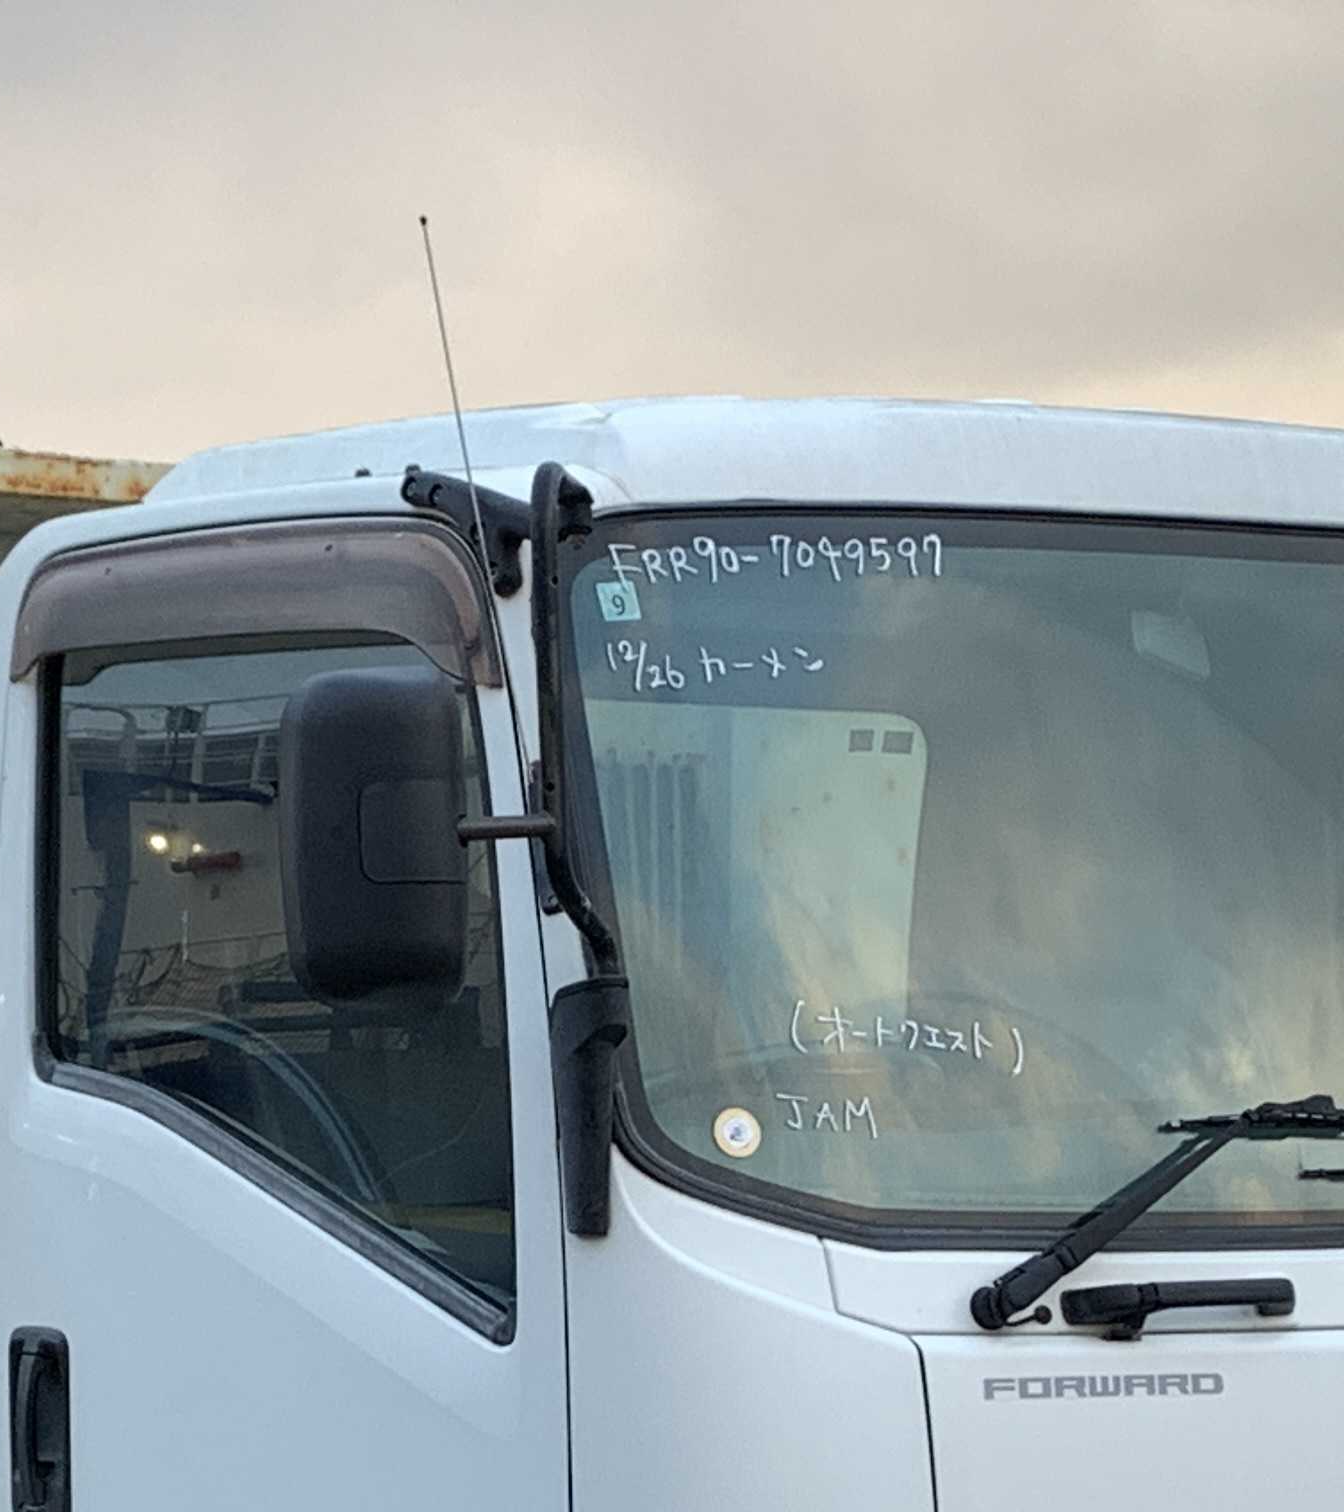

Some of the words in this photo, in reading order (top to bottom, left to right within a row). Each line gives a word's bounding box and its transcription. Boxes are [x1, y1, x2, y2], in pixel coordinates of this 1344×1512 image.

[607, 533, 943, 593] FRR90-7049597
[611, 593, 626, 617] 9
[605, 639, 686, 692] 12/26
[775, 1093, 879, 1140] JAM
[982, 1372, 1225, 1401] FORWARD
